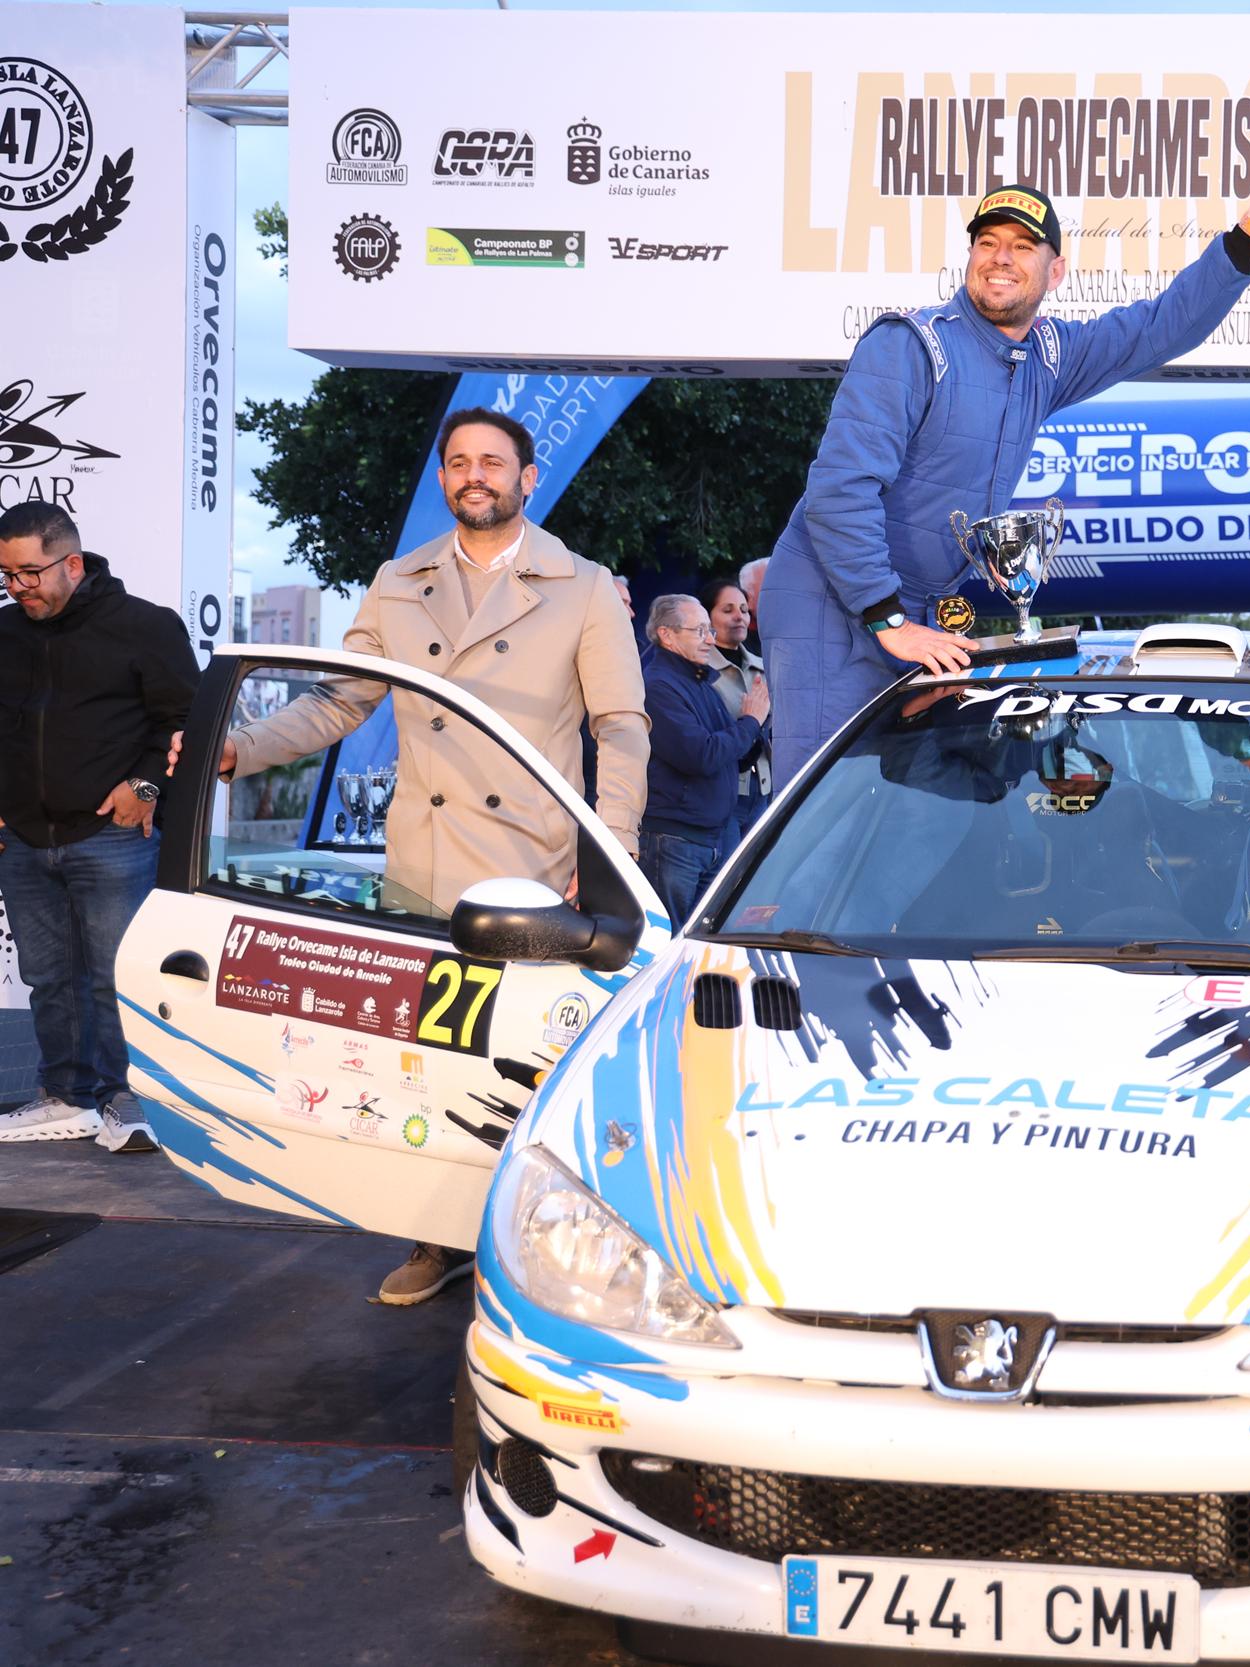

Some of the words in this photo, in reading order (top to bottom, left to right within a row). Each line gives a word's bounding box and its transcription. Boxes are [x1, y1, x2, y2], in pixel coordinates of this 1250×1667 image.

[0, 108, 41, 164] 47
[22, 74, 85, 203] LANZAROTE
[351, 127, 385, 157] FCA
[881, 98, 1004, 197] RALLYE
[1017, 97, 1209, 198] ORVECAME
[609, 145, 692, 161] Gobierno
[330, 168, 404, 182] AUTOMOVILISMO
[608, 163, 629, 178] de
[632, 165, 710, 180] Canarias
[608, 184, 633, 195] islas
[636, 185, 677, 198] iguales
[981, 194, 1042, 216] PIRELLI
[1056, 216, 1131, 239] Ciudad
[1131, 217, 1152, 238] de
[1159, 217, 1227, 239] Arrec
[474, 238, 537, 250] Campeonato
[539, 240, 553, 249] BP
[484, 250, 506, 258] Rallyes
[920, 325, 944, 366] sparco
[1041, 324, 1057, 364] sparco
[201, 232, 226, 512] Orvecame
[447, 360, 725, 375] Orvecame
[191, 397, 200, 453] Cabrera
[1029, 453, 1135, 475] SERVICIO
[1141, 451, 1240, 472] INSULAR
[191, 459, 199, 510] Medina
[1047, 516, 1204, 545] ABILDO
[225, 923, 256, 959] 47
[256, 930, 288, 951] Rallye
[288, 936, 338, 958] Orvecame
[339, 945, 357, 961] Isla
[358, 949, 372, 964] de
[372, 951, 426, 974] Lanzarote
[280, 955, 307, 969] Trofeo
[308, 961, 342, 976] Ciudad
[343, 966, 355, 978] de
[356, 968, 393, 985] Arrecife
[222, 982, 290, 1004] LANZAROTE
[315, 997, 338, 1009] Cabildo
[338, 1002, 346, 1010] de
[418, 959, 502, 1047] 27
[1205, 980, 1245, 1003] E
[315, 1004, 343, 1017] Lanzarote
[559, 1005, 579, 1027] FCA
[735, 1077, 920, 1112] LAS
[420, 1103, 432, 1115] bp
[350, 1117, 380, 1135] CICAR
[842, 1119, 971, 1145] CHAPA
[991, 1121, 1011, 1146] Y
[1025, 1123, 1198, 1158] PINTURA
[543, 1402, 617, 1430] PIRELLI
[795, 1604, 811, 1624] E
[837, 1570, 1005, 1643] 7441
[1045, 1584, 1178, 1652] CMW
